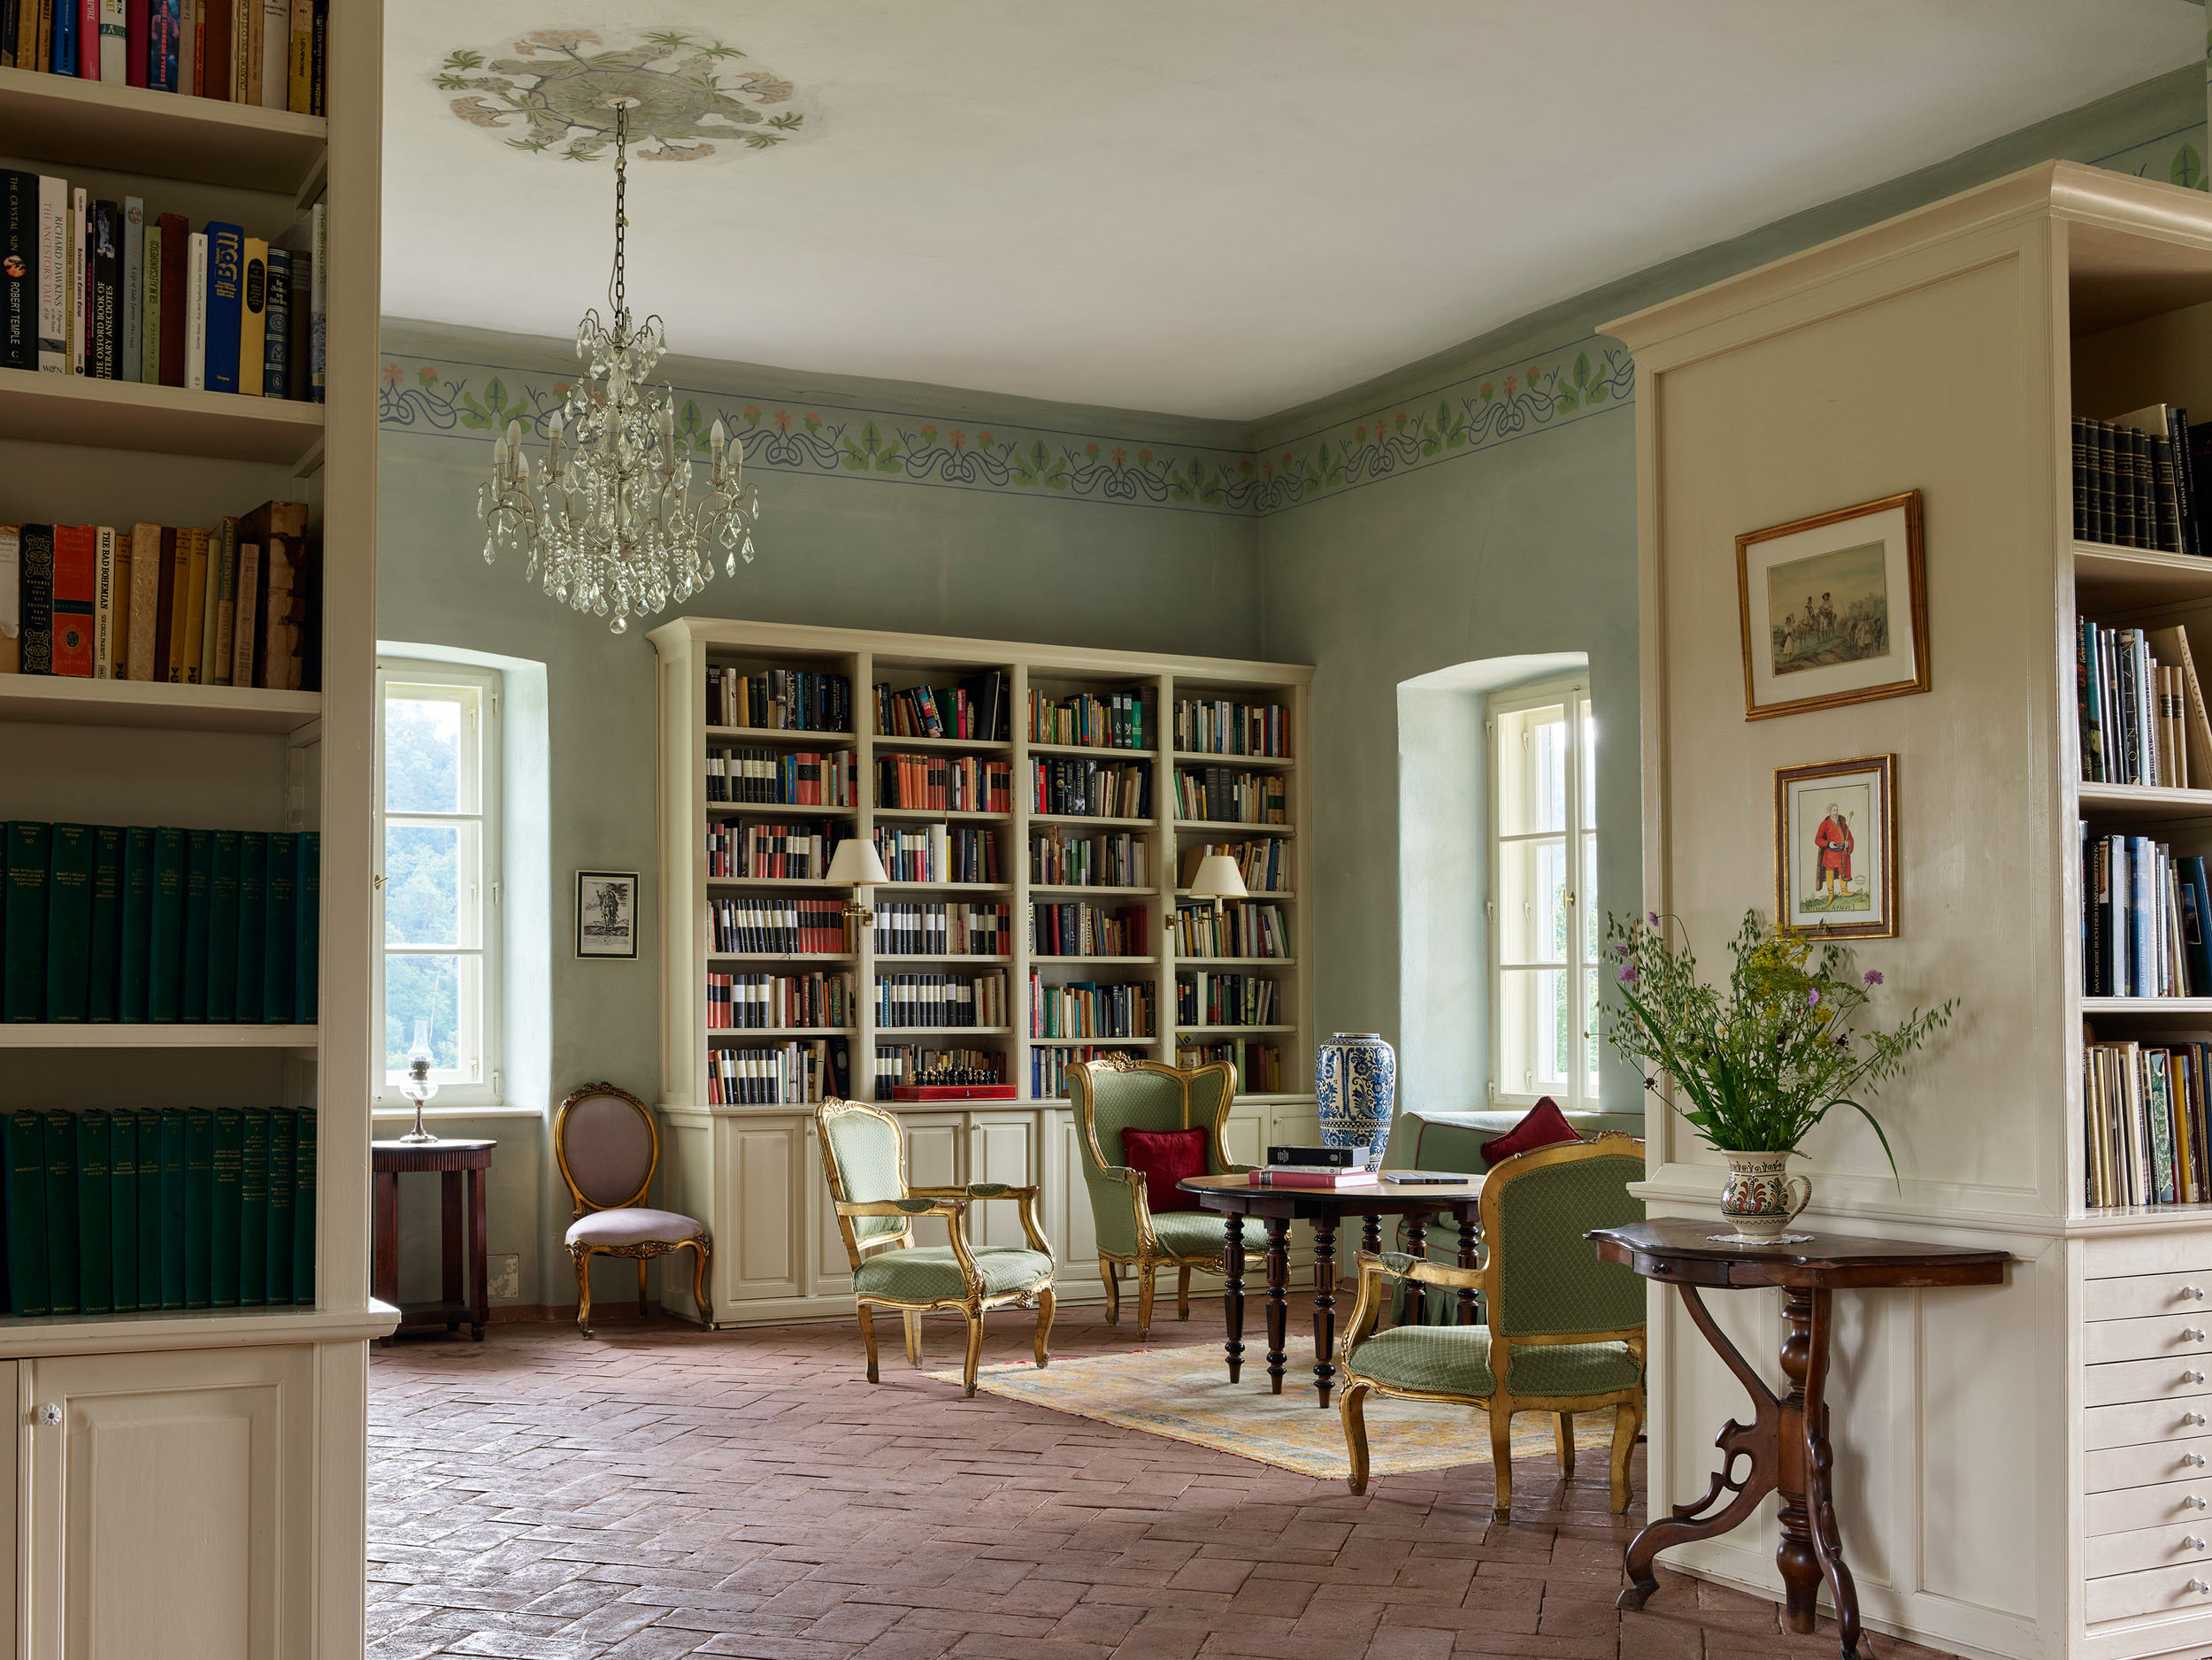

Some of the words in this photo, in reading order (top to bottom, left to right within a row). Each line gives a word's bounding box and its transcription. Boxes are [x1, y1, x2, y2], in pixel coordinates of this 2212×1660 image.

[9, 176, 19, 191] THE
[9, 195, 19, 232] CRYSTAL
[42, 202, 52, 219] THE
[9, 234, 19, 251] SUN
[54, 216, 63, 259] RICHARD
[42, 224, 52, 281] ANCESTOR'S
[10, 281, 20, 314] ROBERT
[42, 283, 51, 305] TALE
[54, 262, 63, 307] DAWKINS
[97, 281, 105, 293] OF
[96, 296, 105, 320] BOOK
[104, 284, 114, 337] ANECDOTES
[10, 315, 20, 344] TEMPLE
[96, 322, 105, 358] OXFORD
[96, 360, 105, 379] THE
[104, 339, 113, 380] LITERARY
[102, 531, 111, 549] THE
[101, 549, 110, 566] BAD
[100, 567, 109, 610] BOHEMIAN
[2181, 637, 2193, 667] VAN
[2188, 673, 2206, 720] GOGH
[2093, 843, 2100, 853] IV
